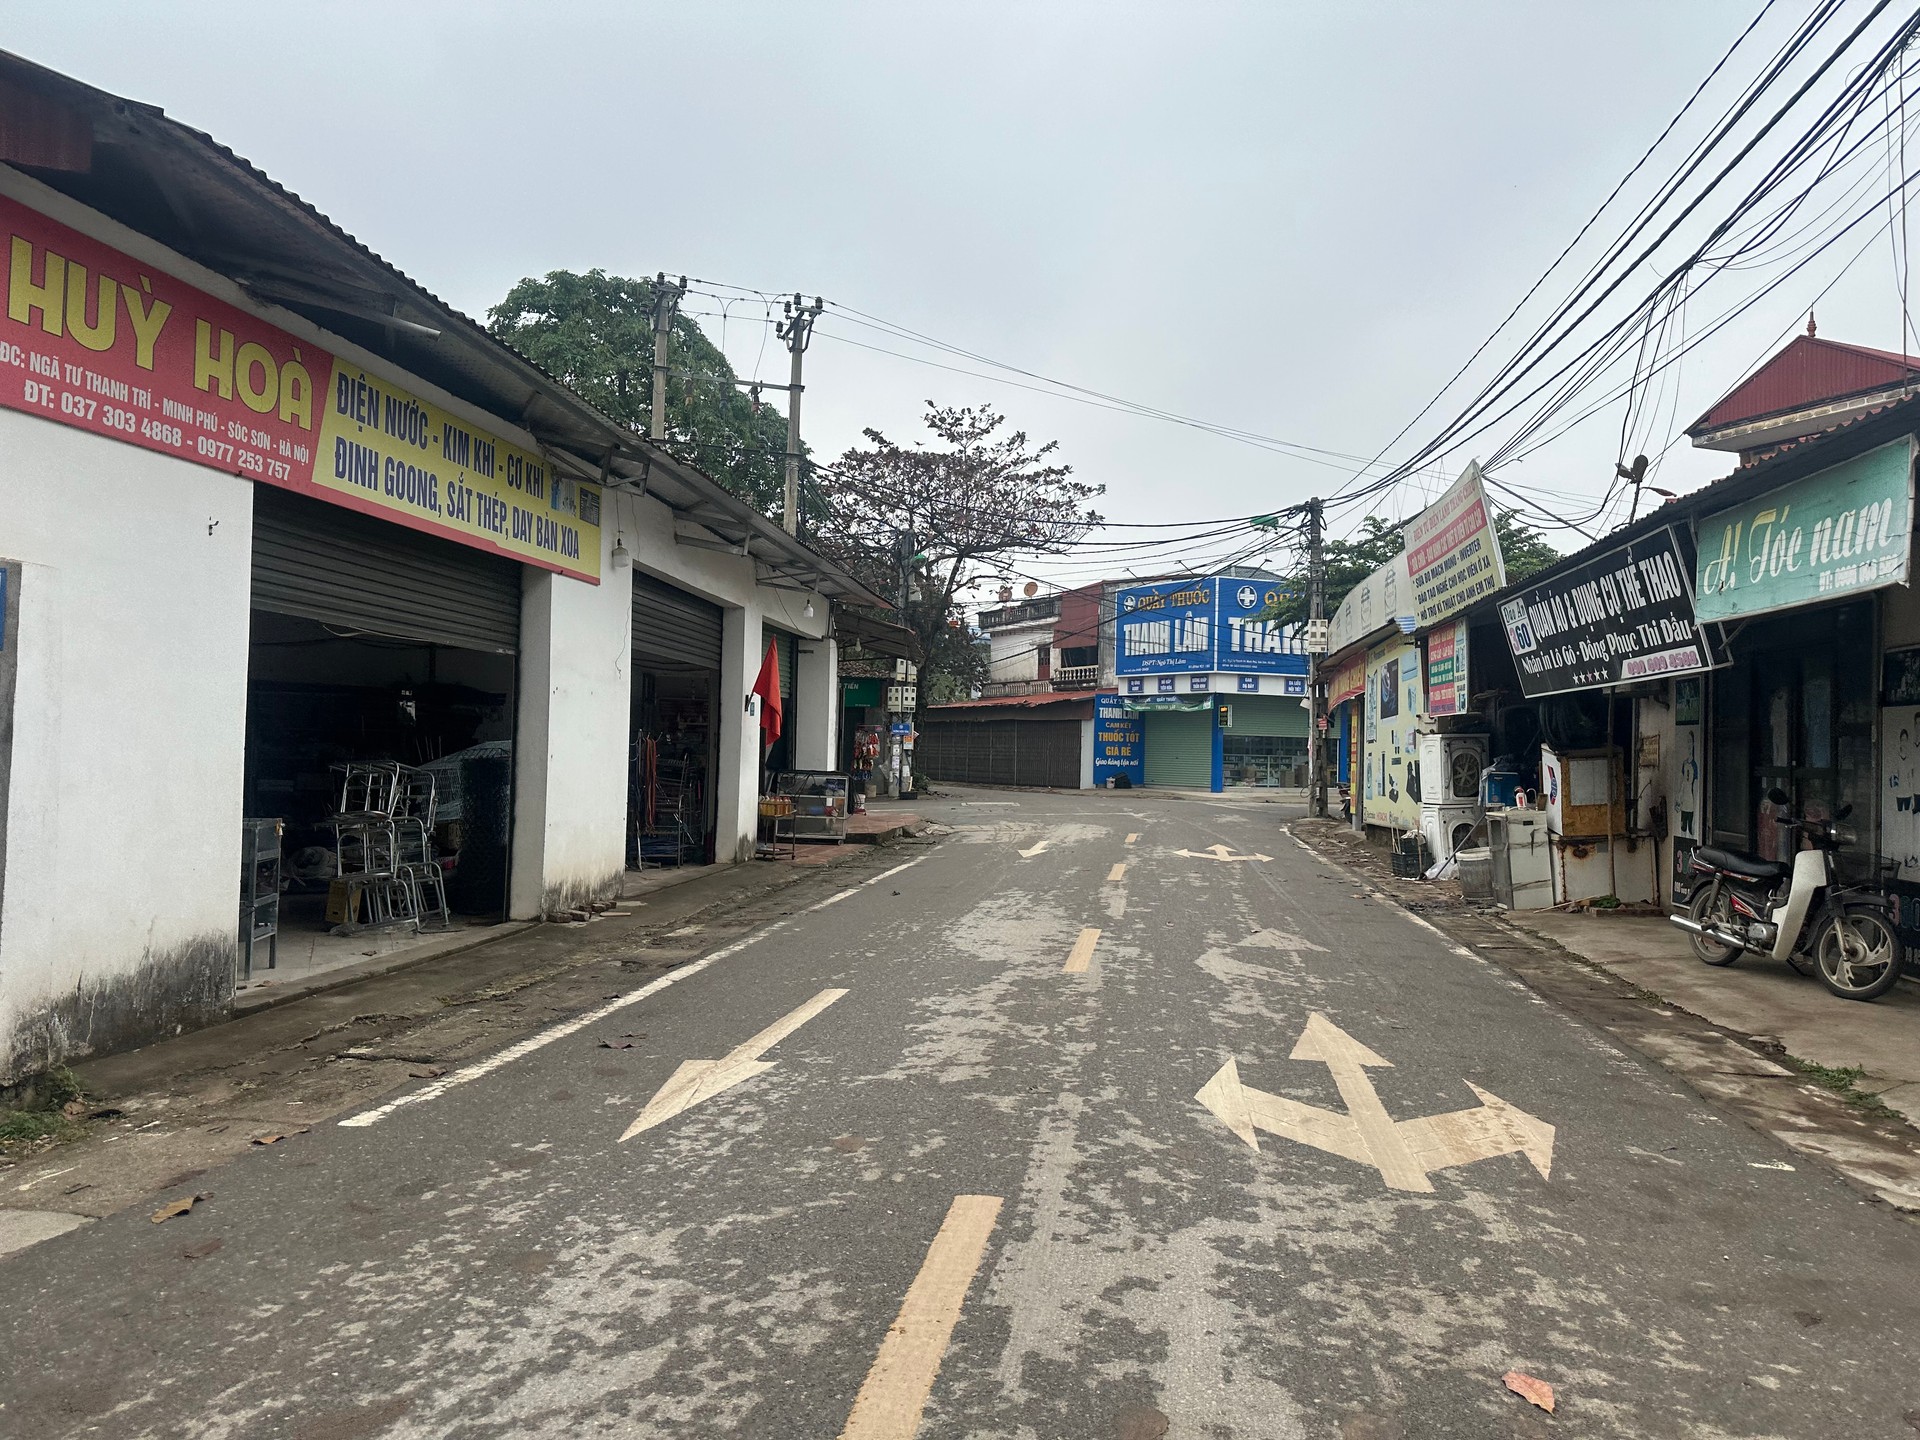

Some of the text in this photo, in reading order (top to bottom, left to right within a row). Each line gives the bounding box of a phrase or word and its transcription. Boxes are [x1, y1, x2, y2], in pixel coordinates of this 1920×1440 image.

[8, 235, 313, 431] HUỲ HOÀ
[0, 341, 309, 464] ĐC: NGÃ TƯ THANH TRÍ MINH PHÚ SÓC SƠN HÀ NỘI
[24, 379, 291, 479] ĐT: 037 303 4868 0977 253 757
[336, 371, 545, 500] ĐIỆN NƯỚC KIM KHÍ CƠ KHÍ
[334, 436, 580, 560] ĐINH GOONG, SẮT THÉP, DAY BÀN XOA
[1482, 555, 1491, 569] XA
[1749, 505, 1802, 584] Tóc
[1810, 497, 1893, 567] nam
[1138, 583, 1210, 611] QUẦY THUỐC
[1528, 546, 1682, 643] QUẦN ÁO & DỤNG CỤ THỂ THAO
[1124, 611, 1208, 656] THANH LÂM
[1509, 623, 1532, 651] 360
[1521, 612, 1693, 678] Nhận in Lô Gô Đồng Phục Thi Đấu
[1098, 729, 1140, 742] THUỐC TỐT
[1099, 708, 1122, 718] THANH
[1096, 758, 1107, 766] Giao
[1108, 758, 1120, 767] hàng
[1106, 743, 1132, 756] GIÁ RẺ
